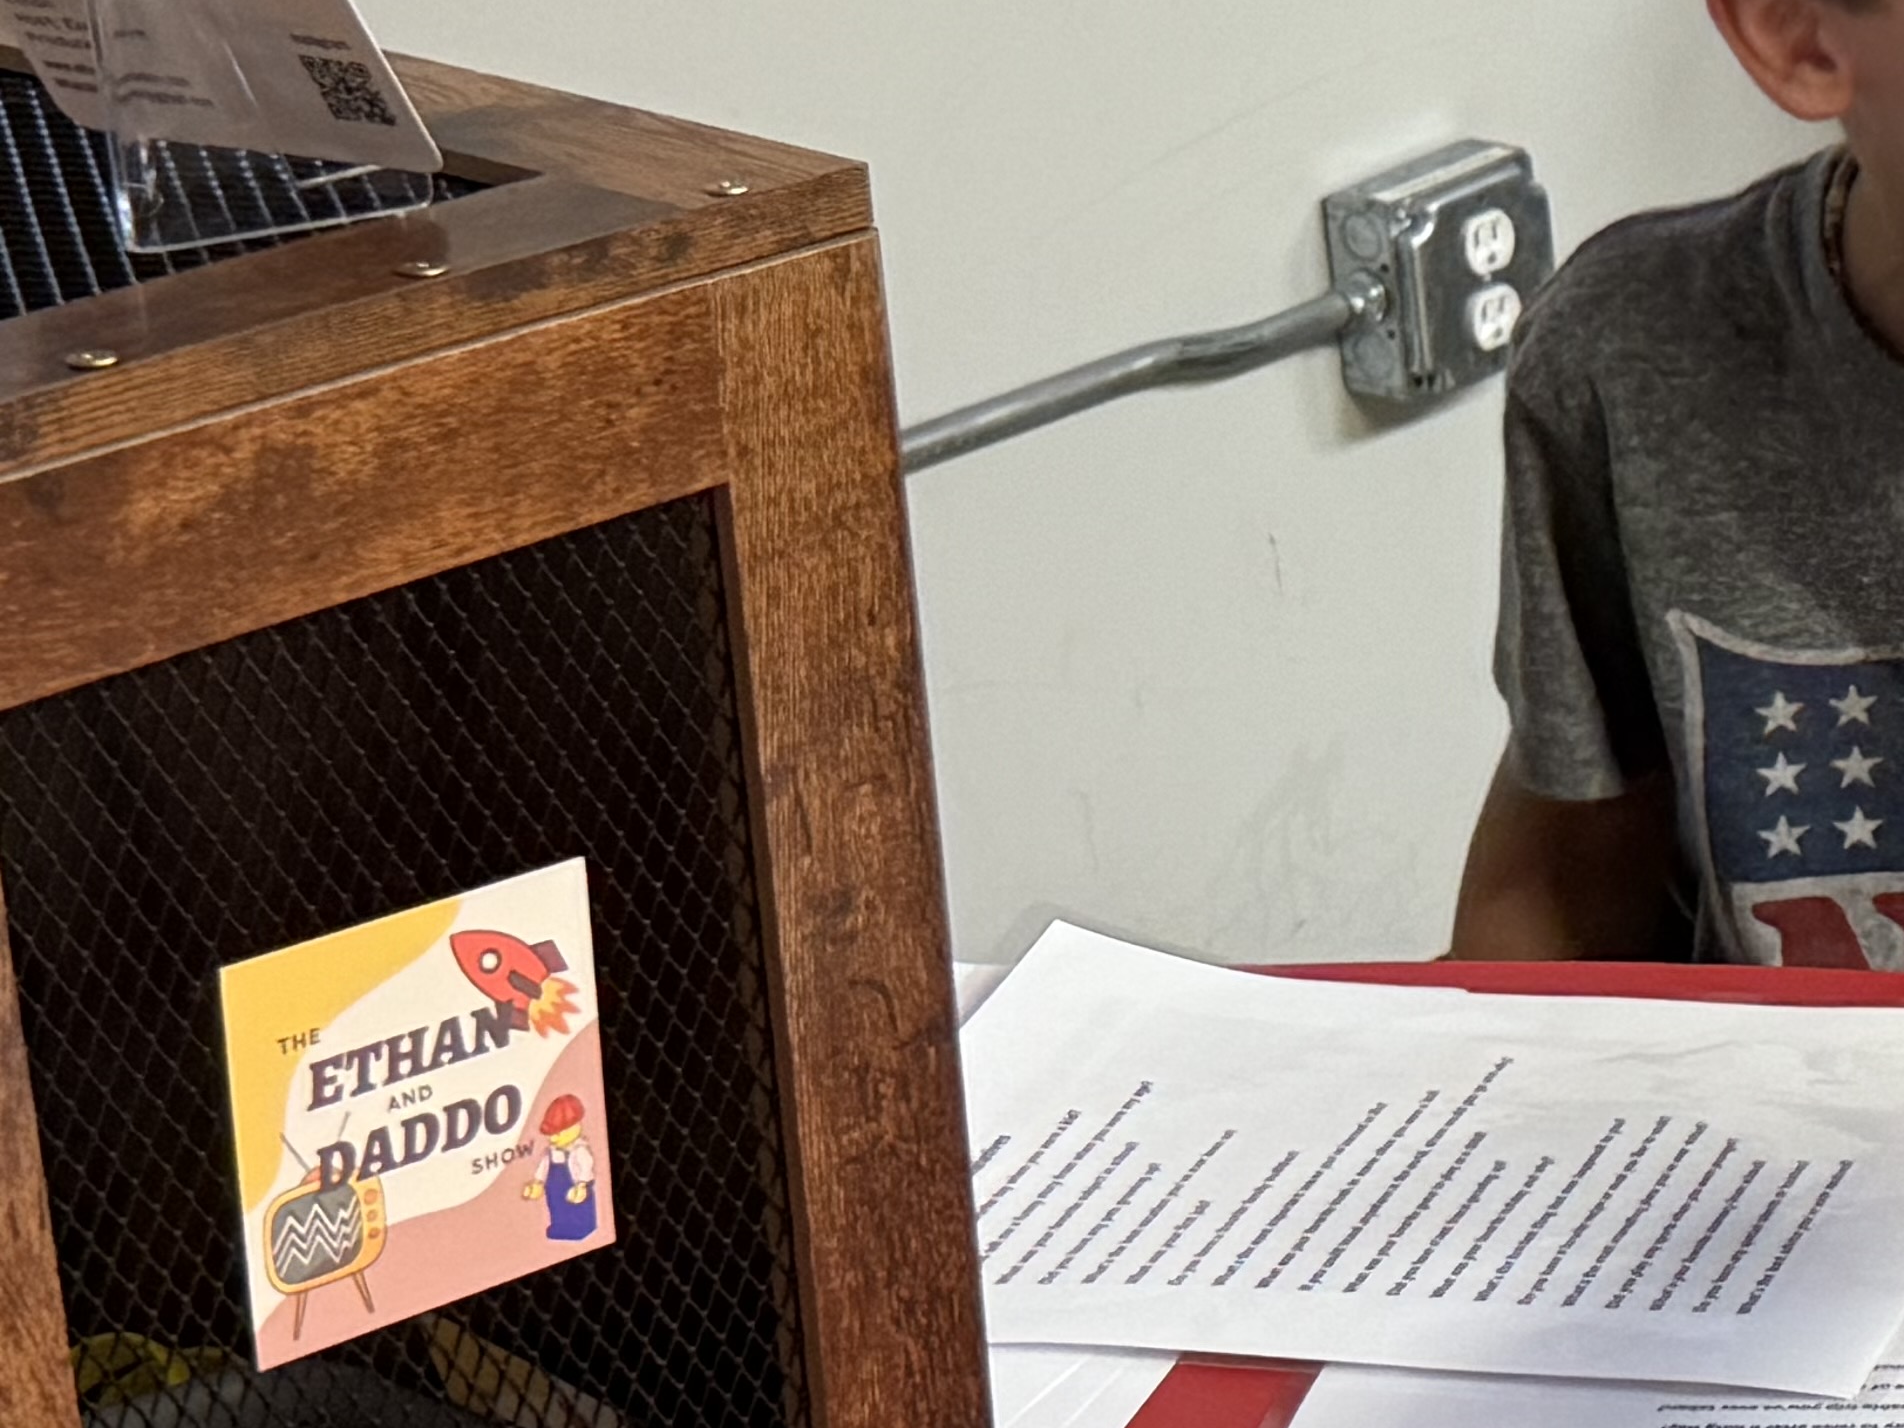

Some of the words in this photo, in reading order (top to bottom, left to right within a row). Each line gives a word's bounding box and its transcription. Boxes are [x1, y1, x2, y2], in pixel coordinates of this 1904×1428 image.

[277, 1027, 321, 1054] THE
[306, 1000, 517, 1112] ETHAN
[387, 1084, 433, 1113] AND
[317, 1083, 523, 1195] DADDO
[471, 1139, 537, 1175] SHOW
